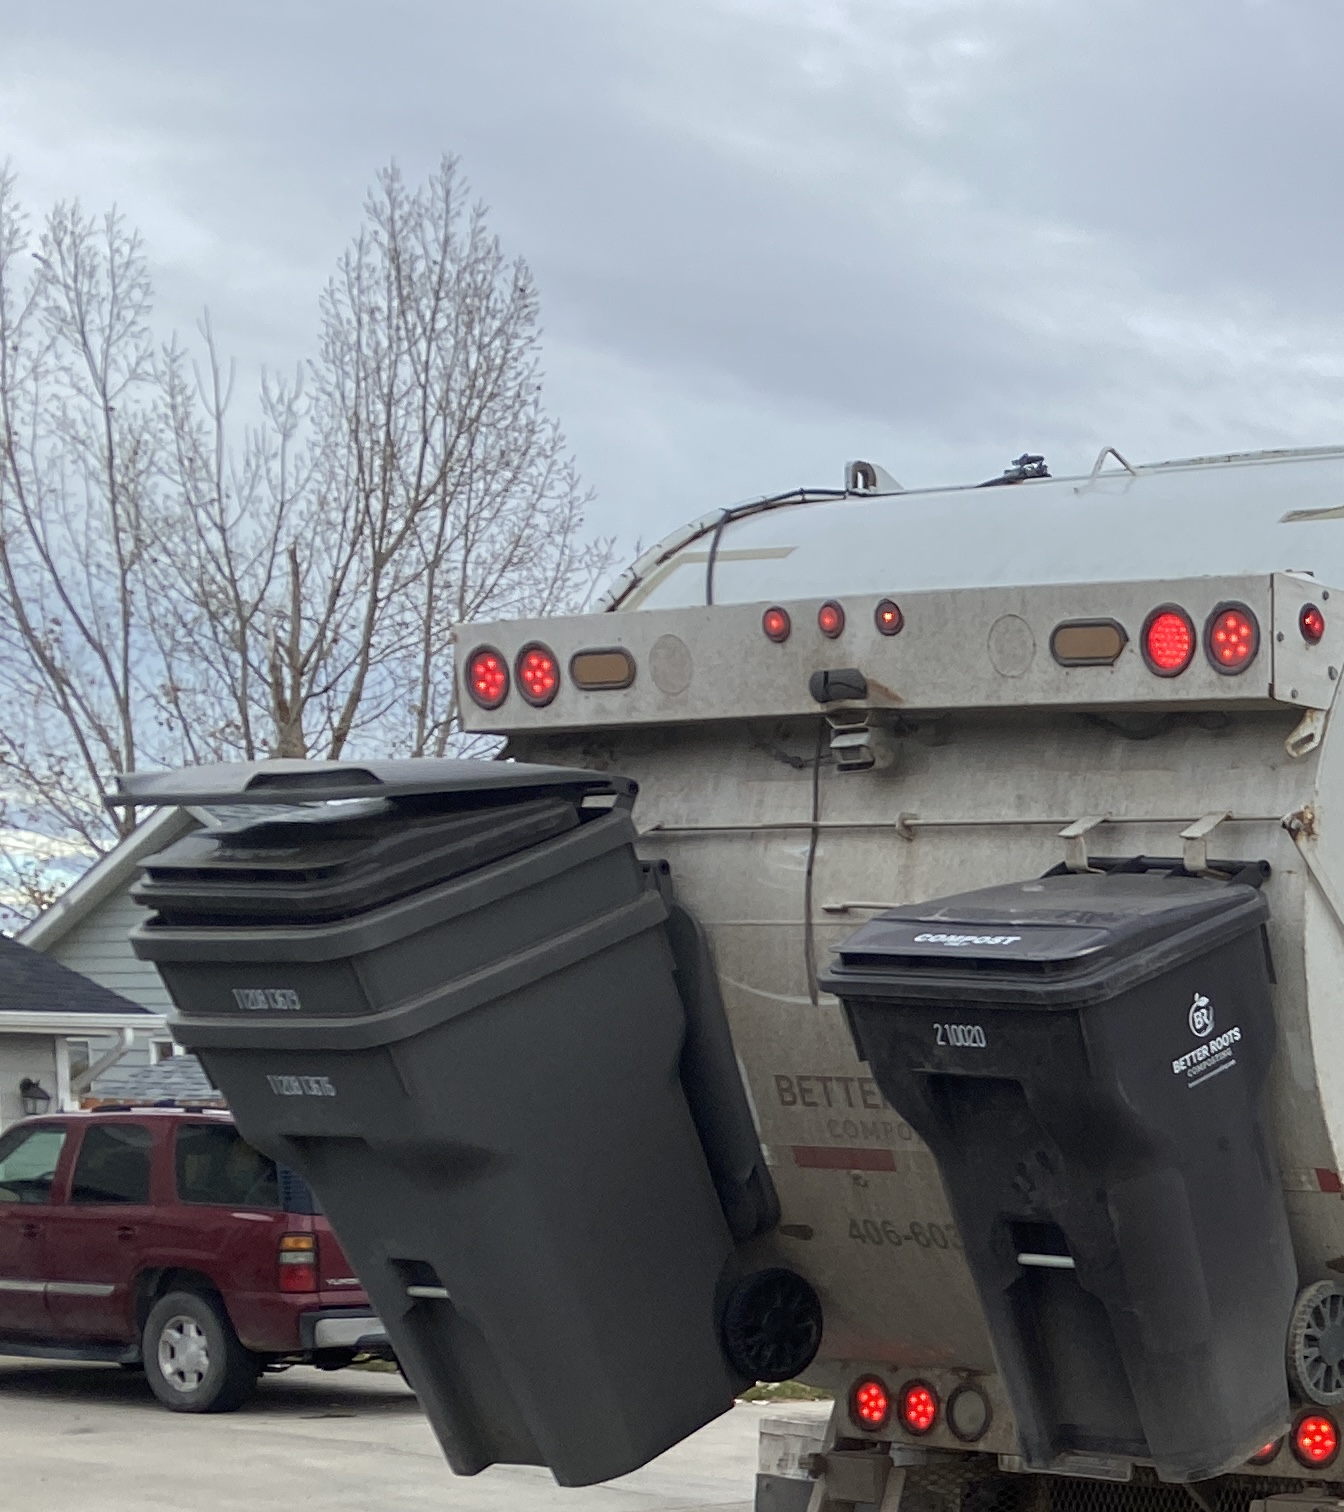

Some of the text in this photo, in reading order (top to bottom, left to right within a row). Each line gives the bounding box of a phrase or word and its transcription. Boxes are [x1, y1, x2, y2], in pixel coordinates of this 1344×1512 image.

[913, 933, 1022, 945] COMPOST
[1172, 1044, 1211, 1074] BETTER
[1209, 1026, 1242, 1053] ROOTS
[774, 1075, 891, 1110] BETTE
[826, 1118, 914, 1141] COMPO
[849, 1218, 964, 1250] 406-603
